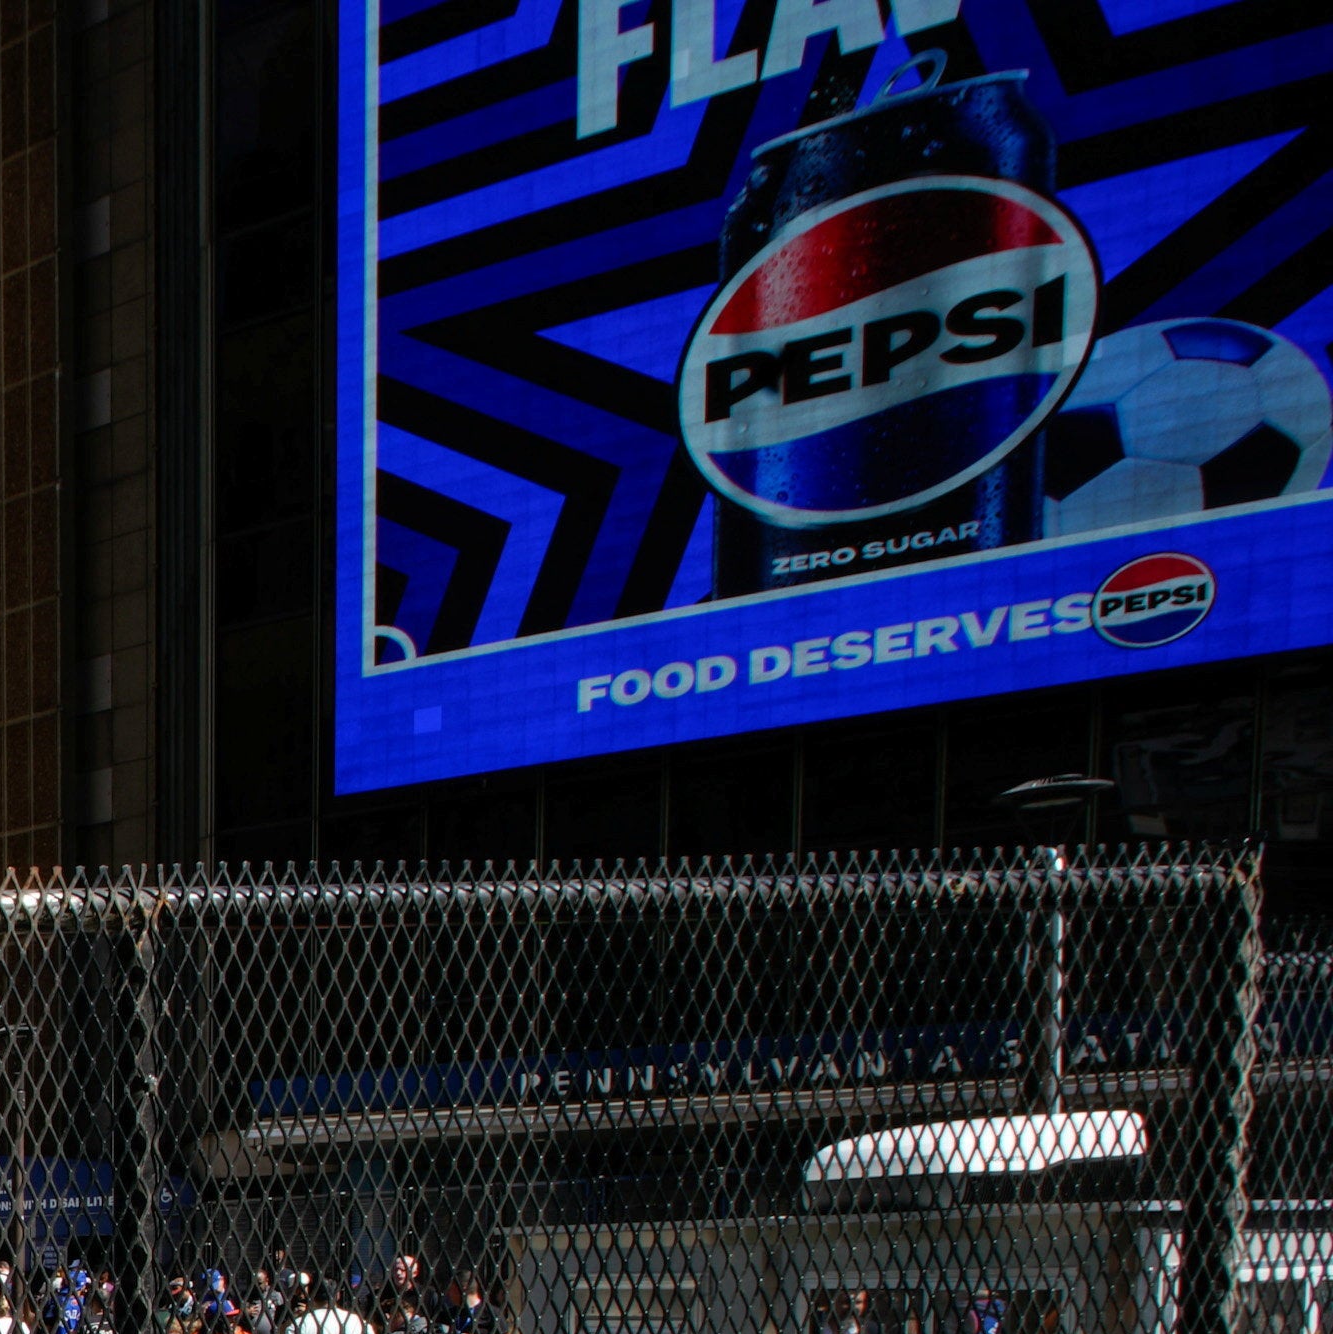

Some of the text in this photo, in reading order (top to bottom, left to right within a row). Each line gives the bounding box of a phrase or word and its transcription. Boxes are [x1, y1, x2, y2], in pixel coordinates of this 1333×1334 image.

[576, 0, 961, 140] FLA
[704, 272, 1068, 425] PEPSI
[771, 520, 981, 575] ZERO SUGAR
[1099, 580, 1209, 620] PEPSI
[576, 591, 1095, 713] FOOD DESERVES
